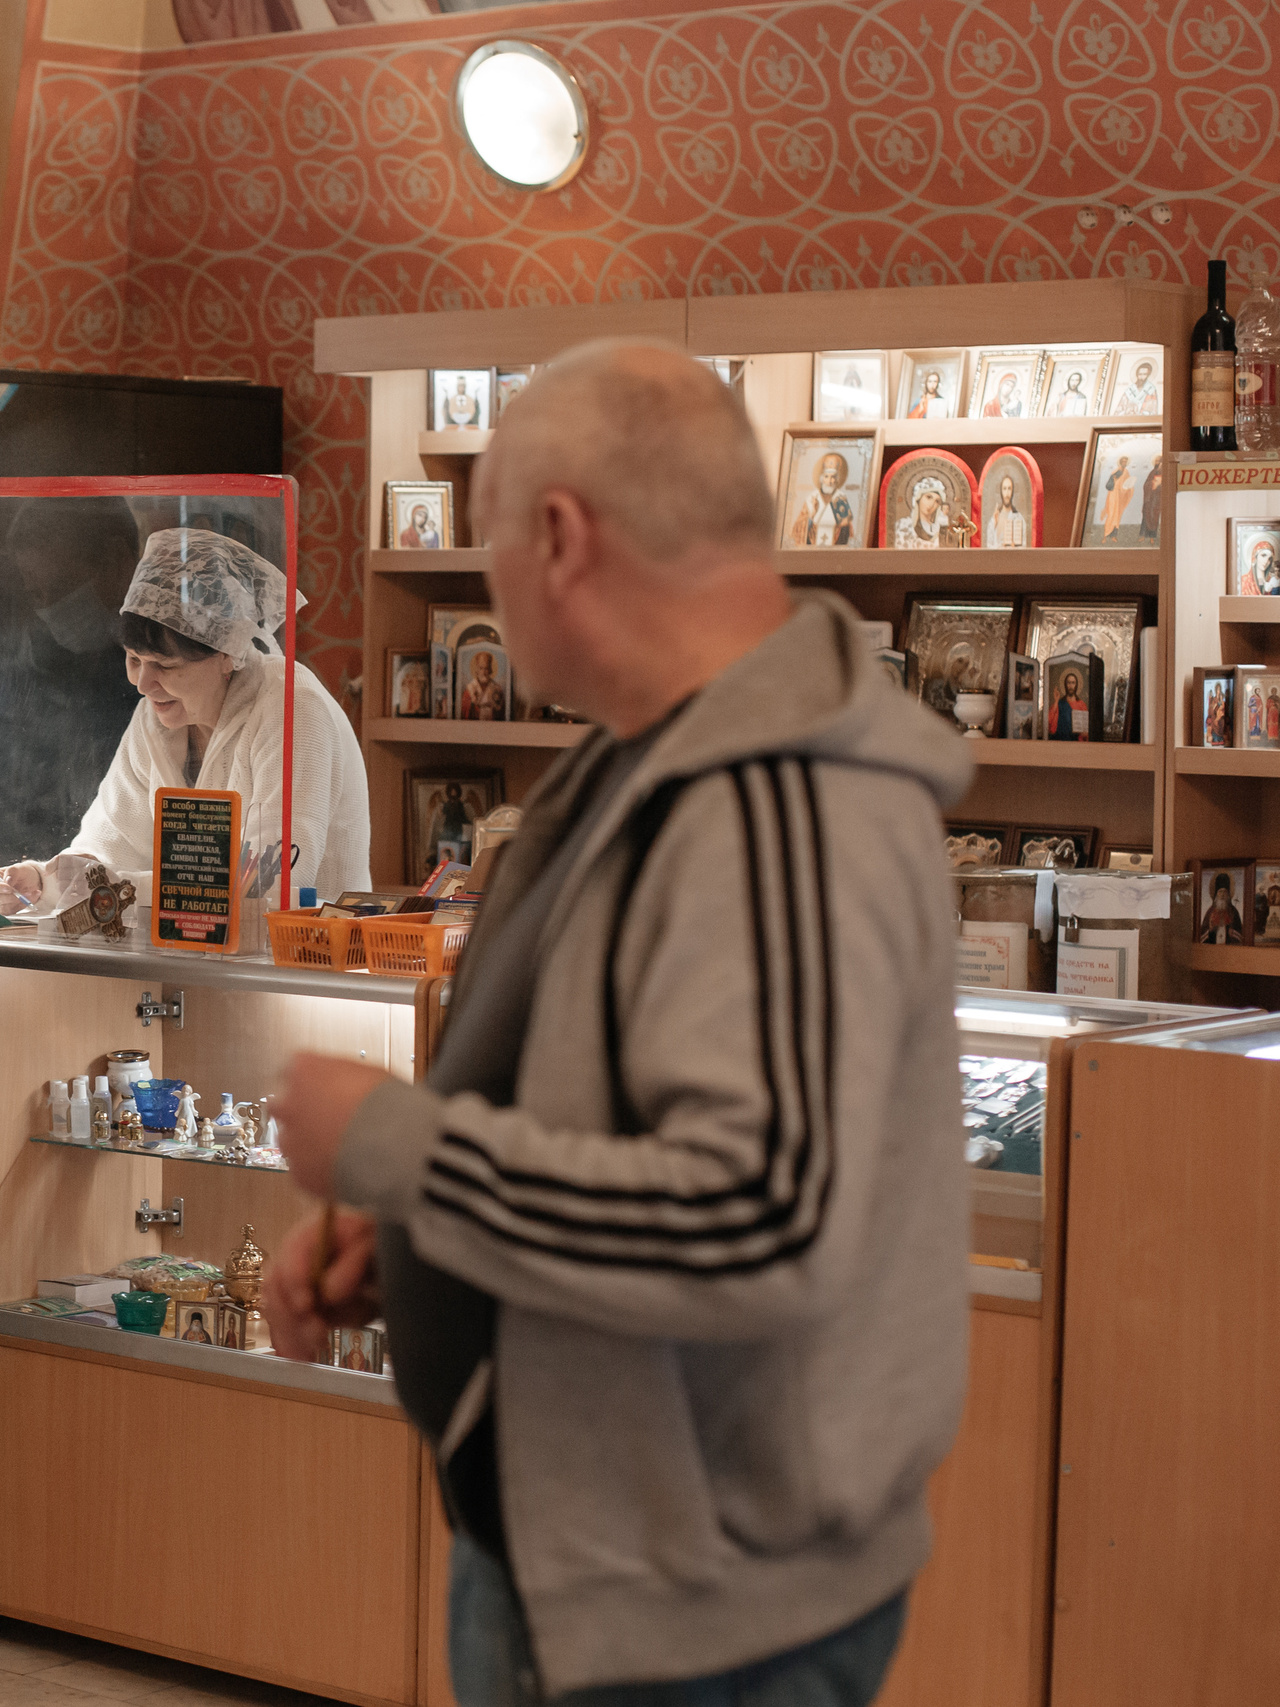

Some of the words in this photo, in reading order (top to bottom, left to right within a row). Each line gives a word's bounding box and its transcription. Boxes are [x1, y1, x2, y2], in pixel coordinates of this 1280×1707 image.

[162, 800, 169, 809] В
[172, 801, 196, 810] особо
[162, 811, 186, 819] момент
[188, 812, 231, 821] богослужени
[163, 821, 187, 830] когда
[170, 854, 199, 863] СИМВОЛ
[177, 873, 195, 881] ОТЧЕ
[198, 874, 215, 882] НАШ
[161, 885, 202, 896] СВЕЧНОЙ
[204, 888, 229, 898] ЯЩИК
[163, 899, 176, 909] НЕ
[182, 900, 228, 913] РАБОТАЕТ
